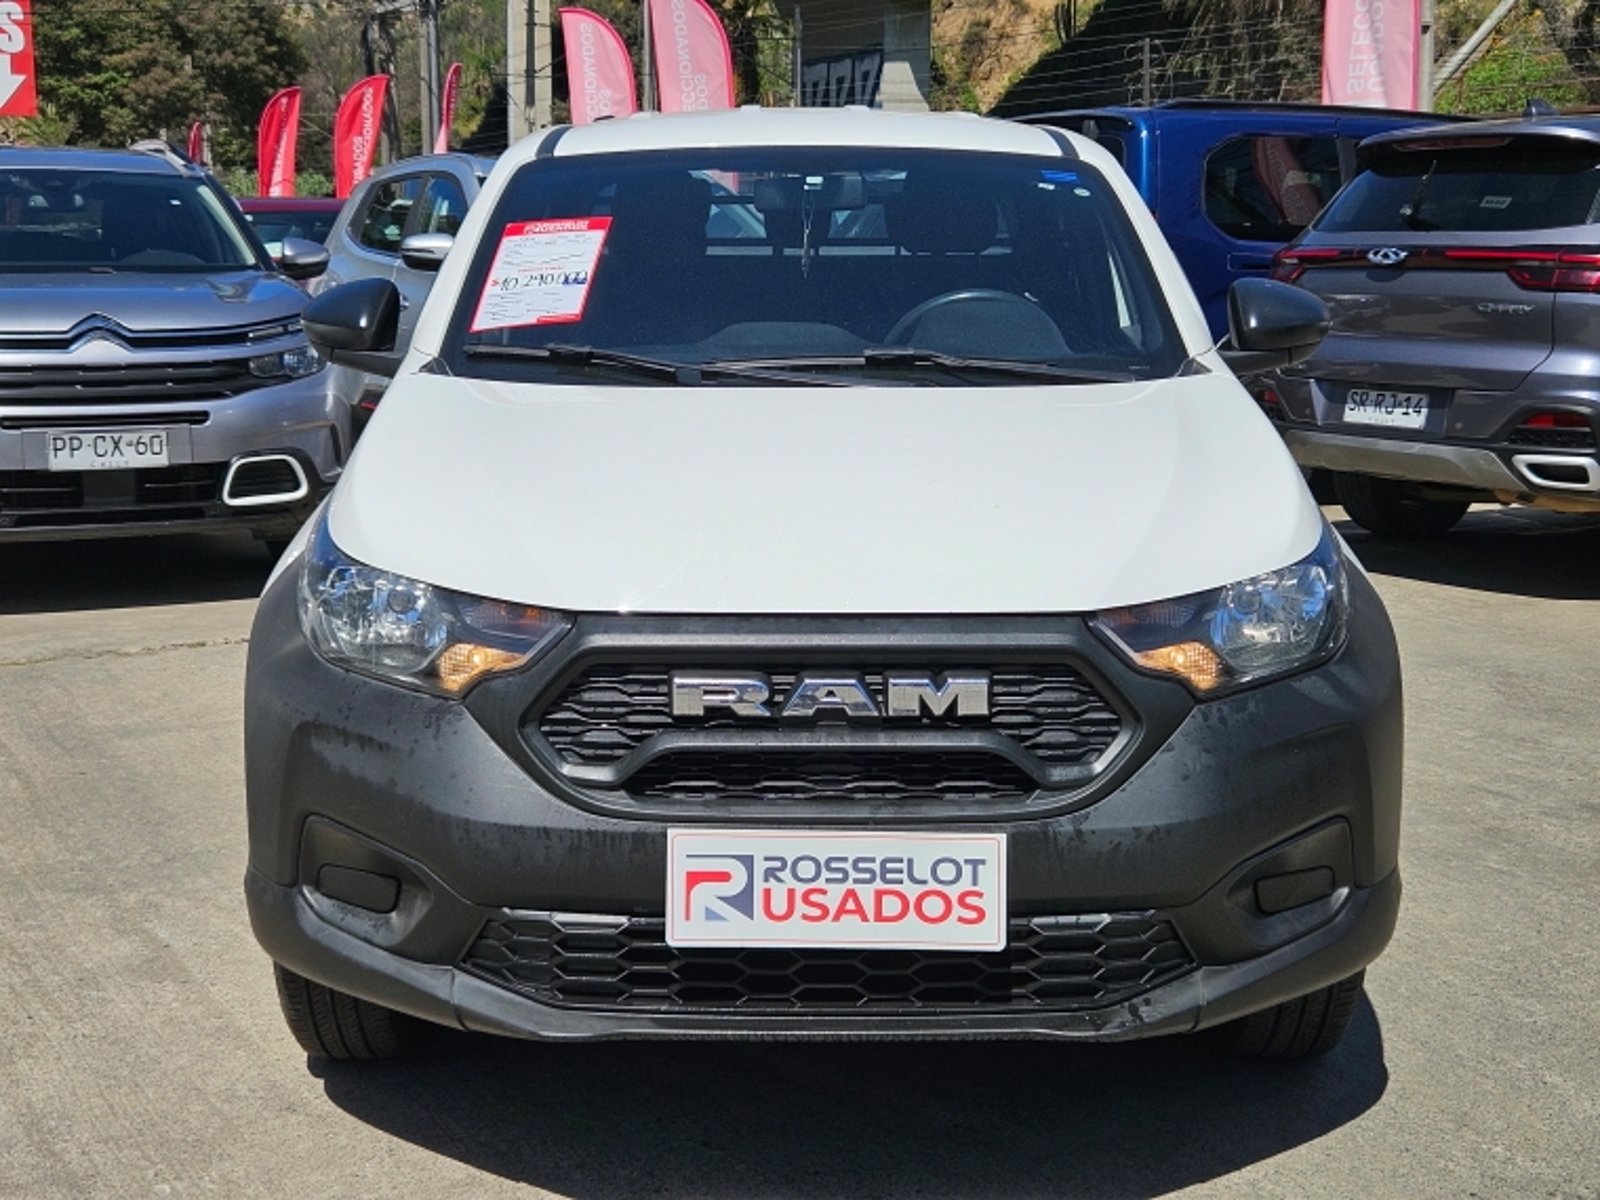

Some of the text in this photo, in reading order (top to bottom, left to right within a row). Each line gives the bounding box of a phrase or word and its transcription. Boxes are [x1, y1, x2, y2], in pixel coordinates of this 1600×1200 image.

[672, 674, 990, 717] RAM
[763, 855, 987, 887] ROSSELOT
[761, 887, 987, 925] USADOS
